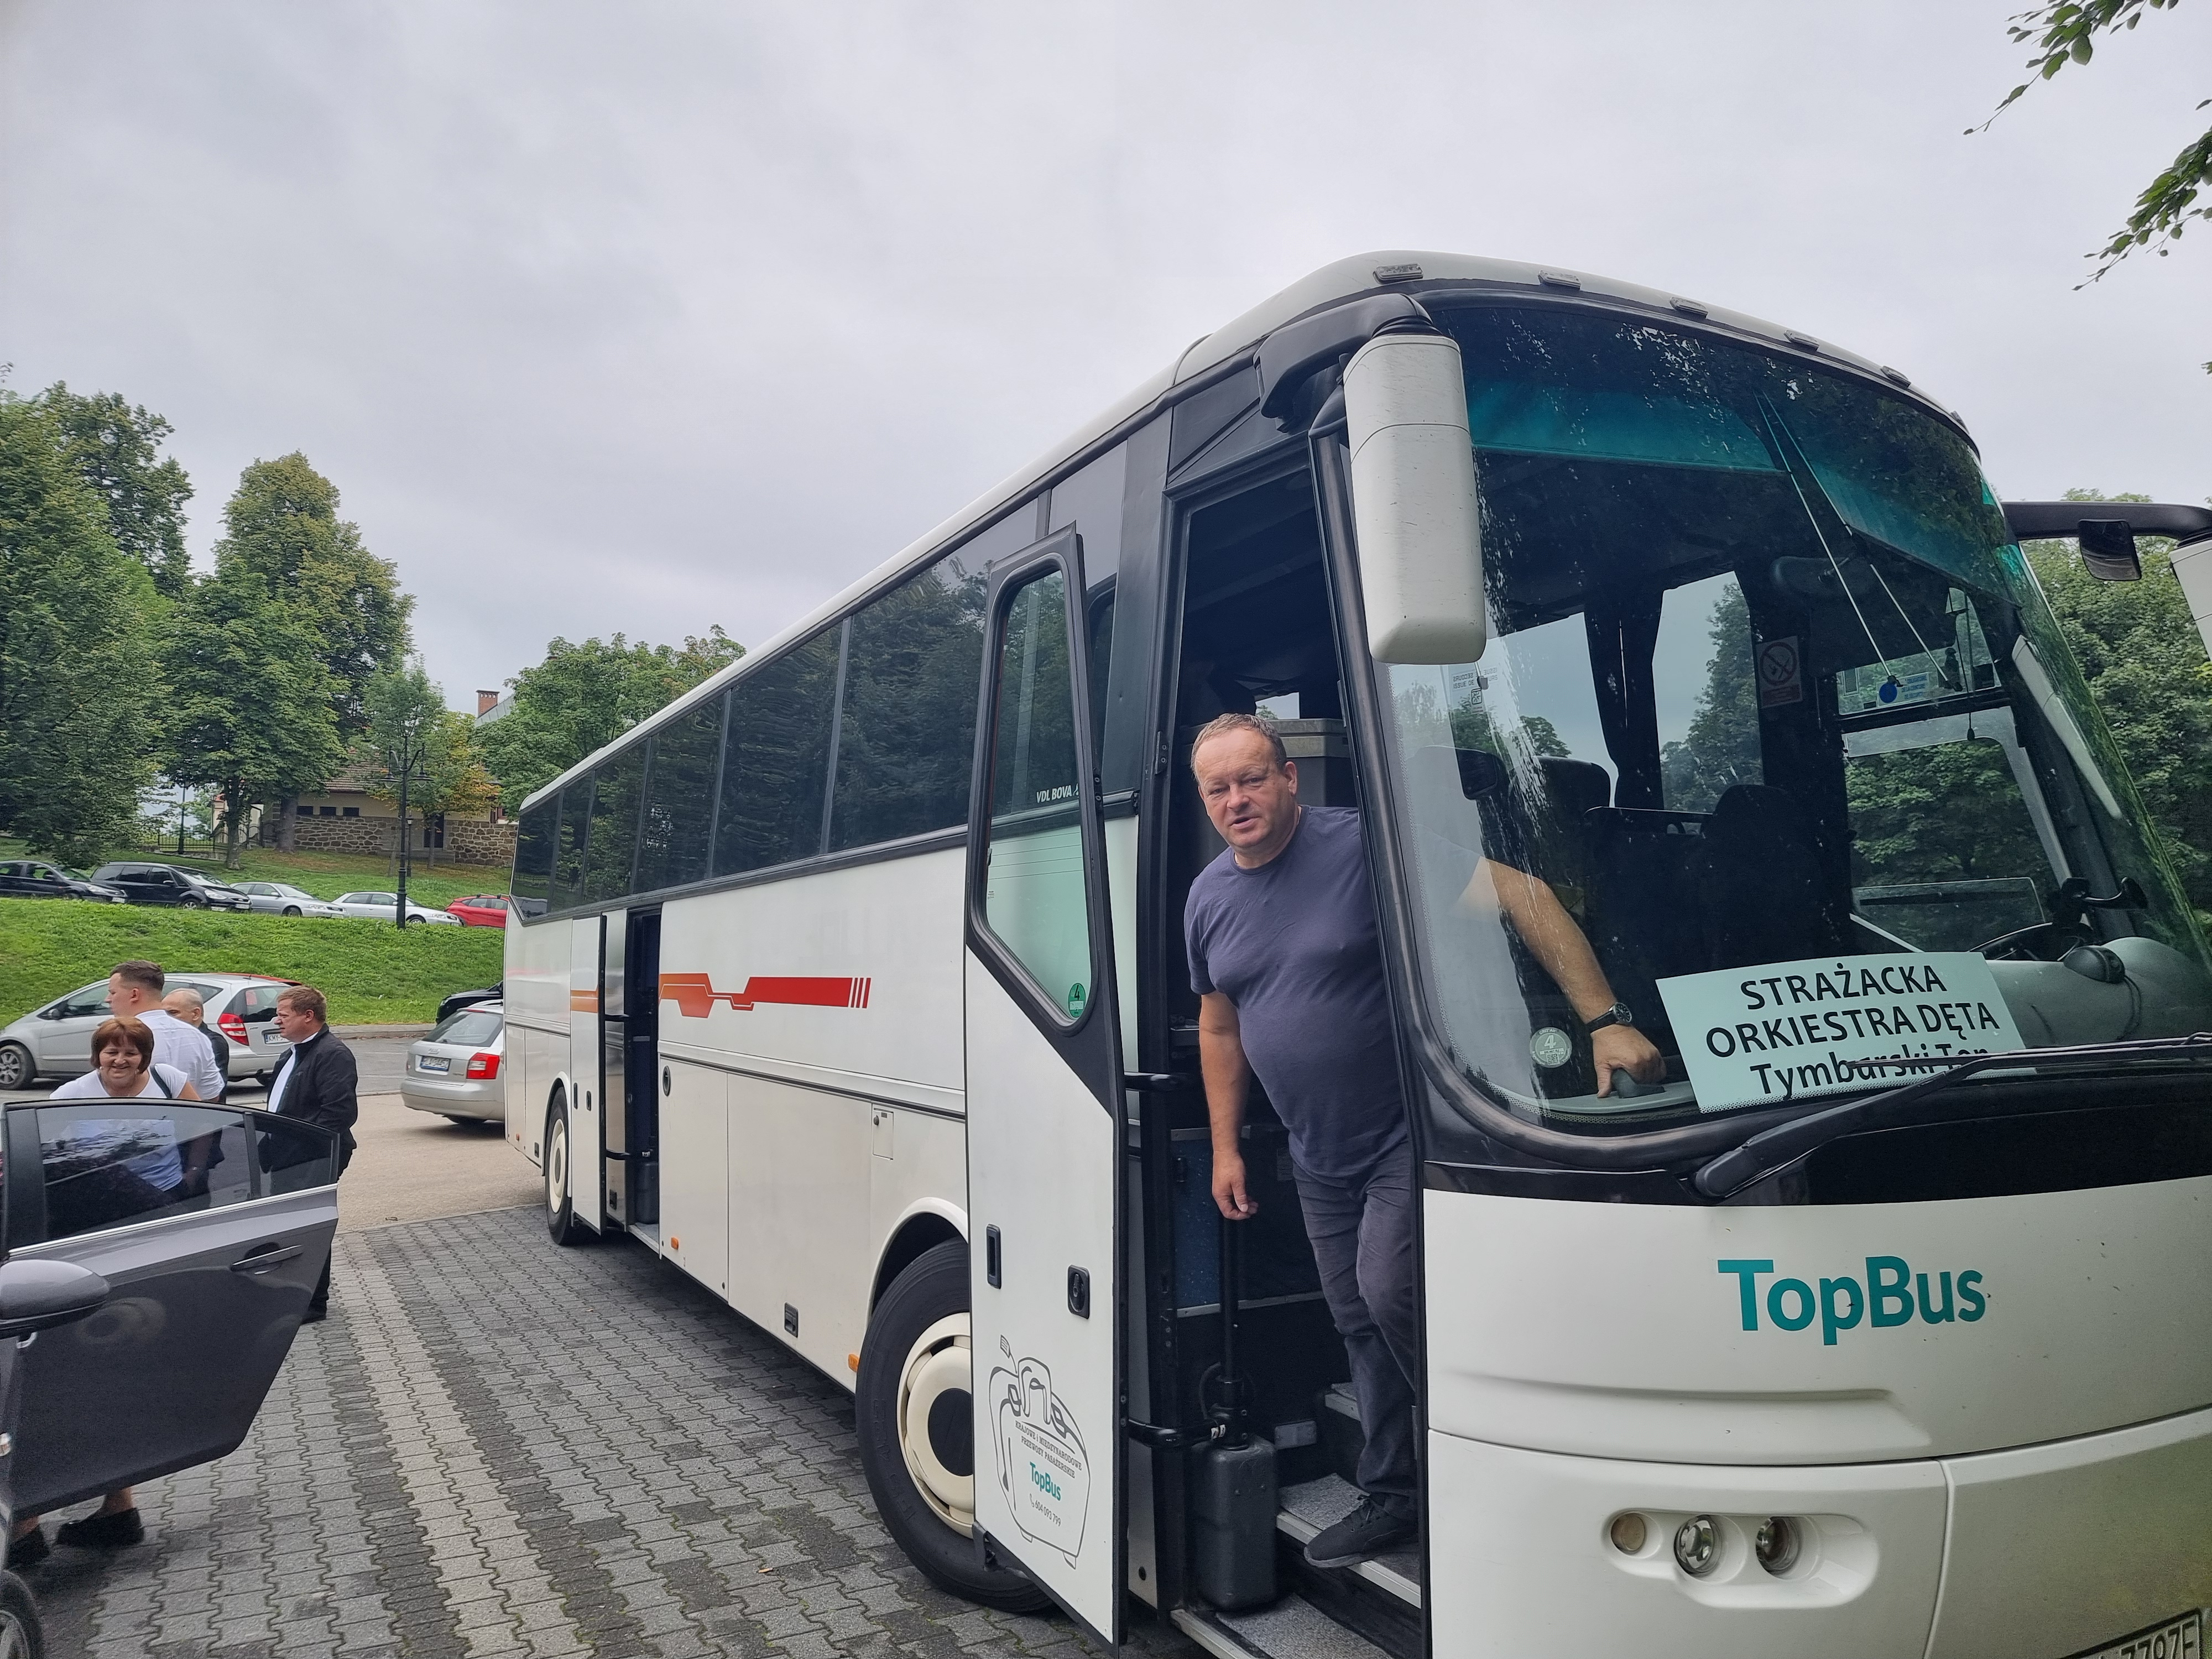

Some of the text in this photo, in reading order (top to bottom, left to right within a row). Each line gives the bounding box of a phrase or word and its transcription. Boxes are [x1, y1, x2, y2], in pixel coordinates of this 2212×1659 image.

[1037, 785, 1072, 803] VDL BOVA
[1074, 985, 1080, 1000] 4
[1740, 962, 1947, 1010] STRAŻACKA
[1545, 1035, 1556, 1048] 4
[1706, 1006, 1916, 1057] ORKIESTRA
[1916, 1002, 2000, 1040] DĘTA
[1718, 1256, 1986, 1345] TopBus
[1015, 1420, 1036, 1439] KRAJOWE
[1039, 1436, 1082, 1471] MIĘDZYNARODOWE
[1021, 1436, 1075, 1479] PRZEWOZY PASAŻERSKIE
[1030, 1462, 1061, 1501] TopBus
[1044, 1506, 1052, 1520] 093
[1052, 1513, 1061, 1526] 799
